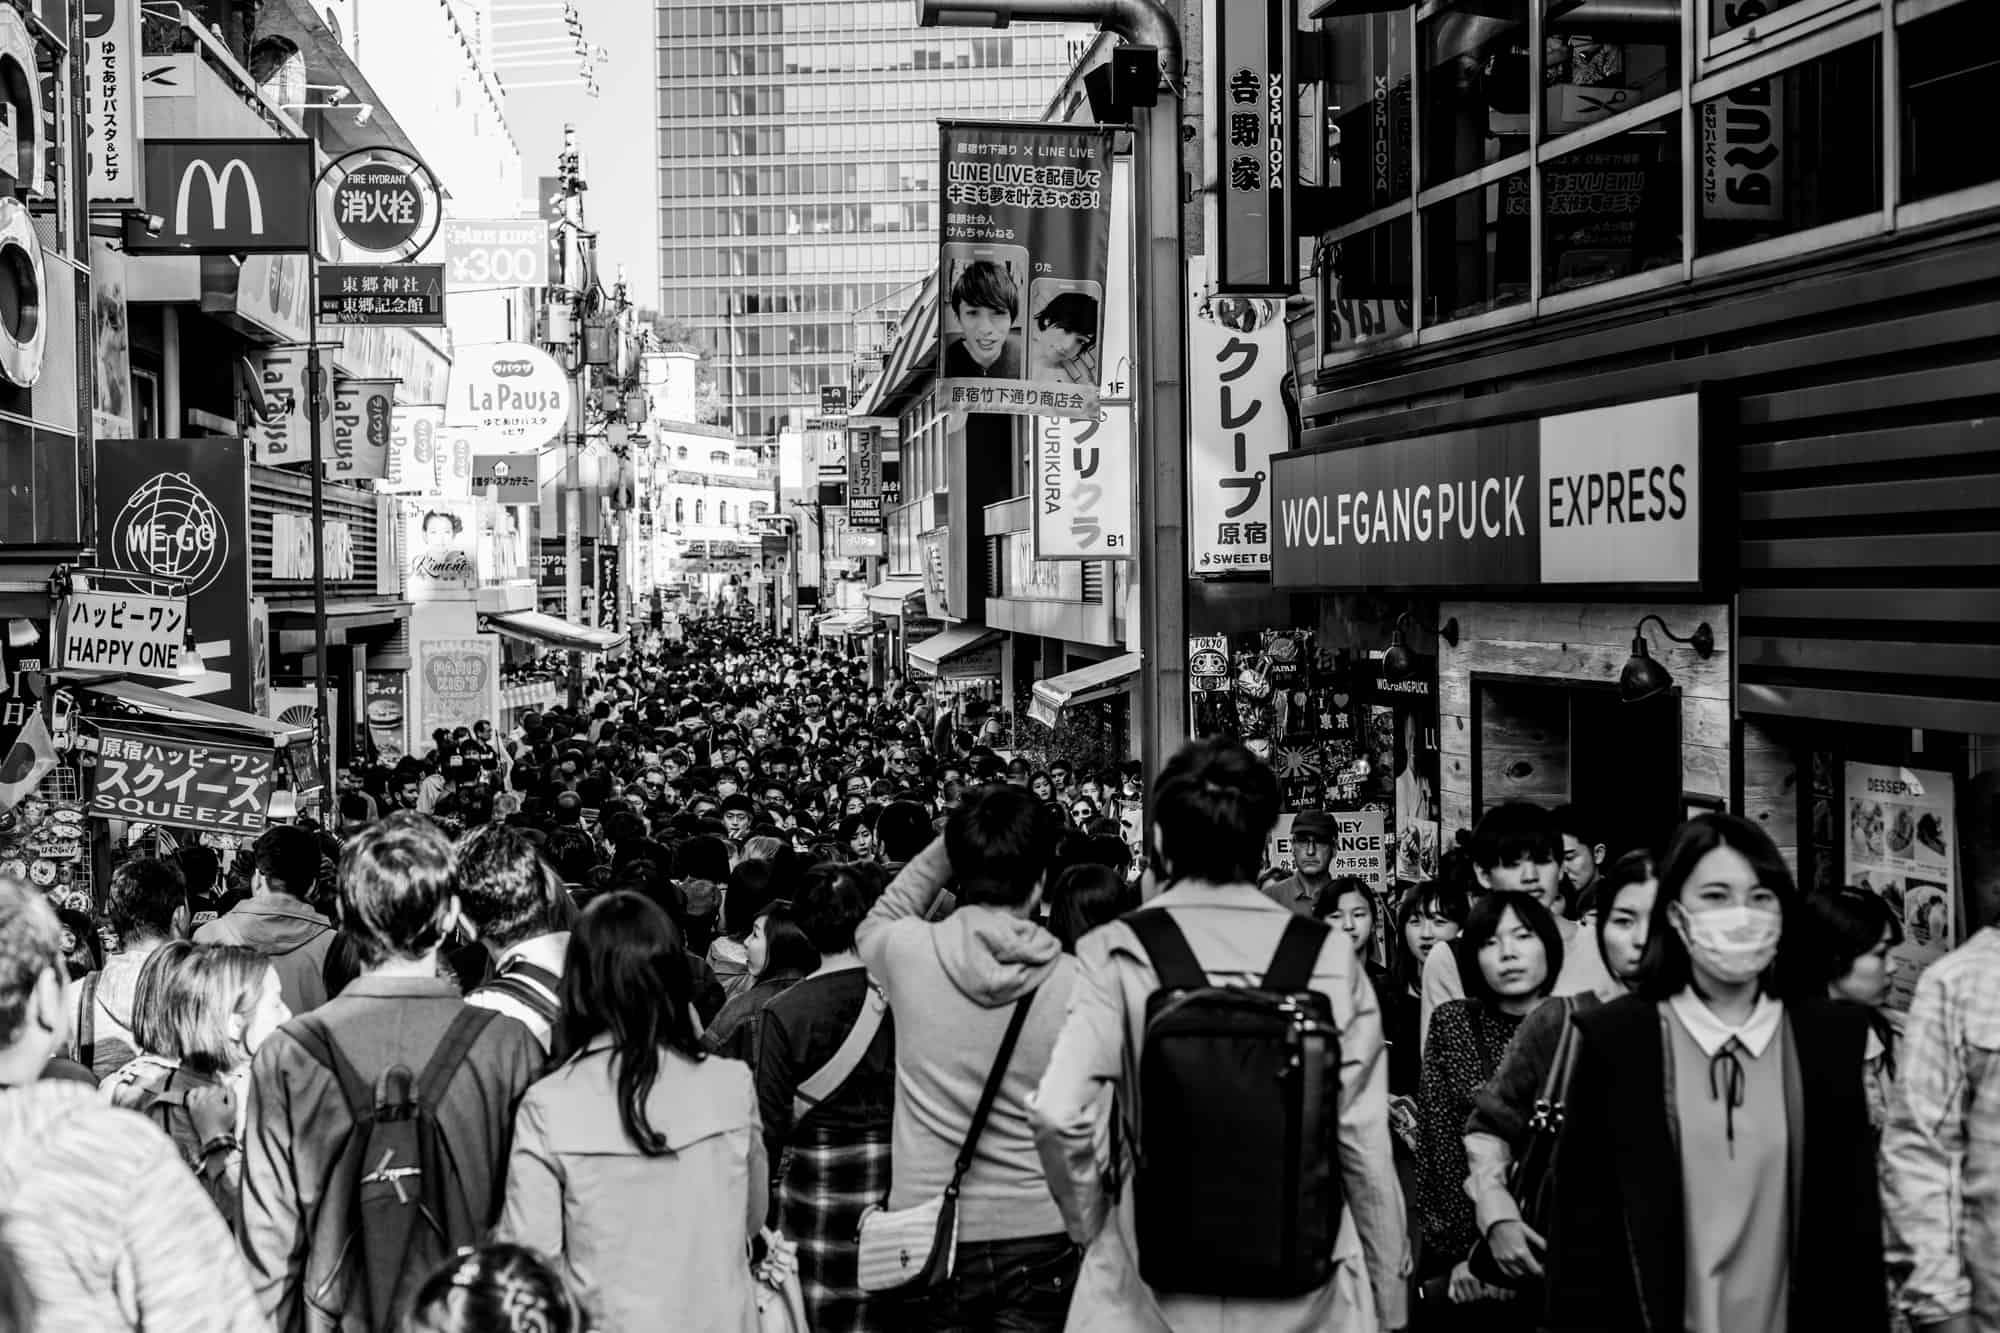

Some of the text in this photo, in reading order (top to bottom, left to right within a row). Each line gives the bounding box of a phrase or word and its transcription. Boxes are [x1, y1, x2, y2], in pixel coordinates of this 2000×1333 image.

[1038, 147, 1066, 157] LINE
[1070, 147, 1096, 158] LIVE
[347, 174, 407, 185] FIRE HYDRANT
[950, 162, 1100, 187] LINE LIVEを配信して
[341, 189, 416, 224] 消火栓
[341, 276, 419, 293] 東郷神社
[341, 297, 424, 314] 東郷記念館
[952, 386, 1084, 409] 原宿竹下通り商店会
[1108, 382, 1125, 394] 1F
[1216, 337, 1266, 519] クレープ
[851, 499, 879, 508] MONEY
[1549, 464, 1687, 528] EXPRESS
[1107, 535, 1124, 547] B1
[1217, 521, 1267, 545] 原宿
[1213, 553, 1258, 564] SWEET
[1260, 553, 1272, 563] B
[72, 601, 182, 632] ハッピーワン
[68, 636, 134, 665] HAPPY
[140, 642, 178, 669] ONE
[1194, 638, 1223, 649] TOKYO
[101, 736, 270, 774] 原宿ハッピーワン
[97, 760, 267, 811] スクイーズ
[1867, 777, 1920, 796] DESSER
[94, 794, 265, 828] SQUEEZE
